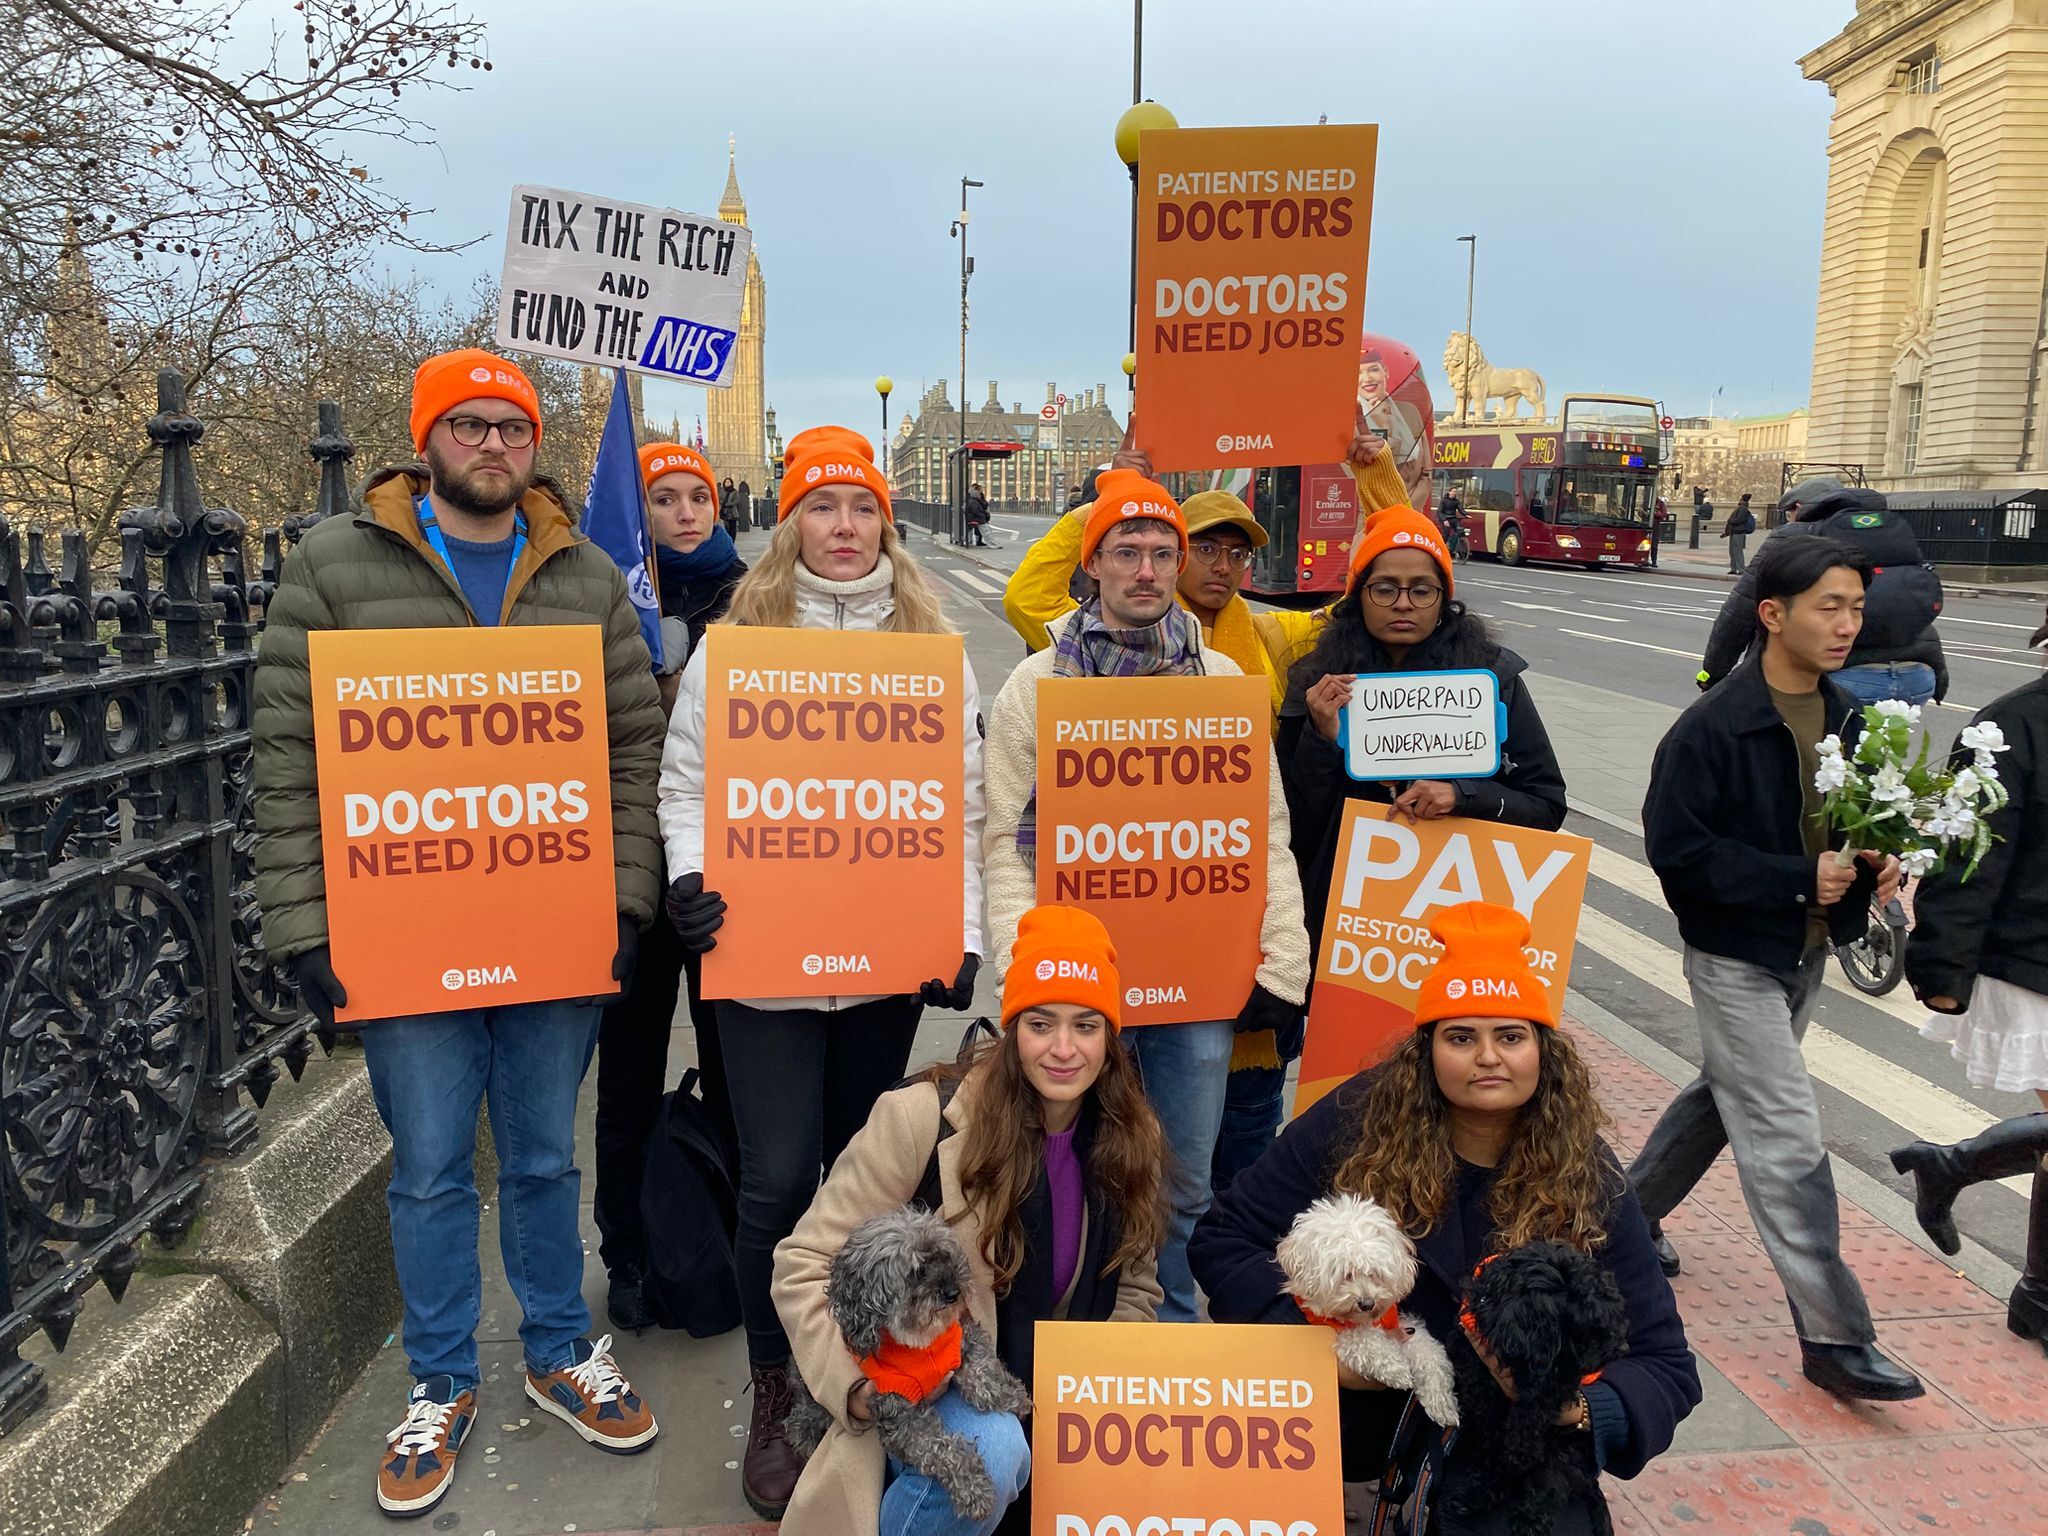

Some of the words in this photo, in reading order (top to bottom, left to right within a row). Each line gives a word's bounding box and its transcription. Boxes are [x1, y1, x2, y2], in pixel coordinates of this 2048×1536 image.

[1157, 170, 1279, 196] PATIENTS
[1286, 168, 1356, 192] NEED
[1157, 197, 1353, 242] DOCTORS
[521, 194, 583, 251] TAX
[594, 207, 645, 262] THE
[658, 218, 736, 276] RICH
[598, 271, 650, 300] AND
[1155, 272, 1348, 318] DOCTORS
[510, 289, 586, 350] FUND
[594, 303, 643, 361] THE
[649, 321, 726, 376] NHS
[1154, 321, 1252, 354] NEED
[1258, 317, 1345, 355] JOBS
[495, 370, 529, 396] BMA
[1234, 434, 1274, 451] BMA
[1532, 437, 1546, 451] BIG
[667, 455, 702, 471] BMA
[825, 463, 866, 480] BMA
[1530, 451, 1545, 464] BUS
[1142, 501, 1177, 521] BMA
[1316, 500, 1352, 509] Emirates
[1414, 533, 1442, 556] BMA
[336, 672, 488, 702] PATIENTS
[497, 670, 582, 696] NEED
[728, 669, 862, 696] PATIENTS
[870, 674, 945, 697] NEED
[1364, 686, 1482, 711] UNDERPAID
[338, 700, 584, 753] DOCTORS
[728, 698, 945, 743] DOCTORS
[1056, 718, 1178, 742] PATIENTS
[1185, 717, 1252, 740] NEED
[1364, 731, 1487, 755] UNDERVALUED
[1056, 744, 1252, 788] DOCTORS
[344, 780, 589, 837] DOCTORS
[727, 777, 945, 821] DOCTORS
[347, 838, 474, 879] NEED
[484, 829, 591, 875] JOBS
[726, 826, 840, 859] NEED
[849, 826, 945, 864] JOBS
[1056, 818, 1251, 864] DOCTORS
[1056, 868, 1158, 901] NEED
[1166, 862, 1250, 902] JOBS
[1340, 816, 1576, 923] PAY
[825, 954, 871, 974] BMA
[1058, 961, 1099, 985] BMA
[1520, 946, 1558, 972] OR
[467, 965, 518, 987] BMA
[1471, 978, 1521, 999] BMA
[1145, 986, 1187, 1005] BMA
[1057, 1375, 1212, 1407] PATIENTS
[1222, 1379, 1314, 1409] NEED
[1057, 1412, 1316, 1471] DOCTORS
